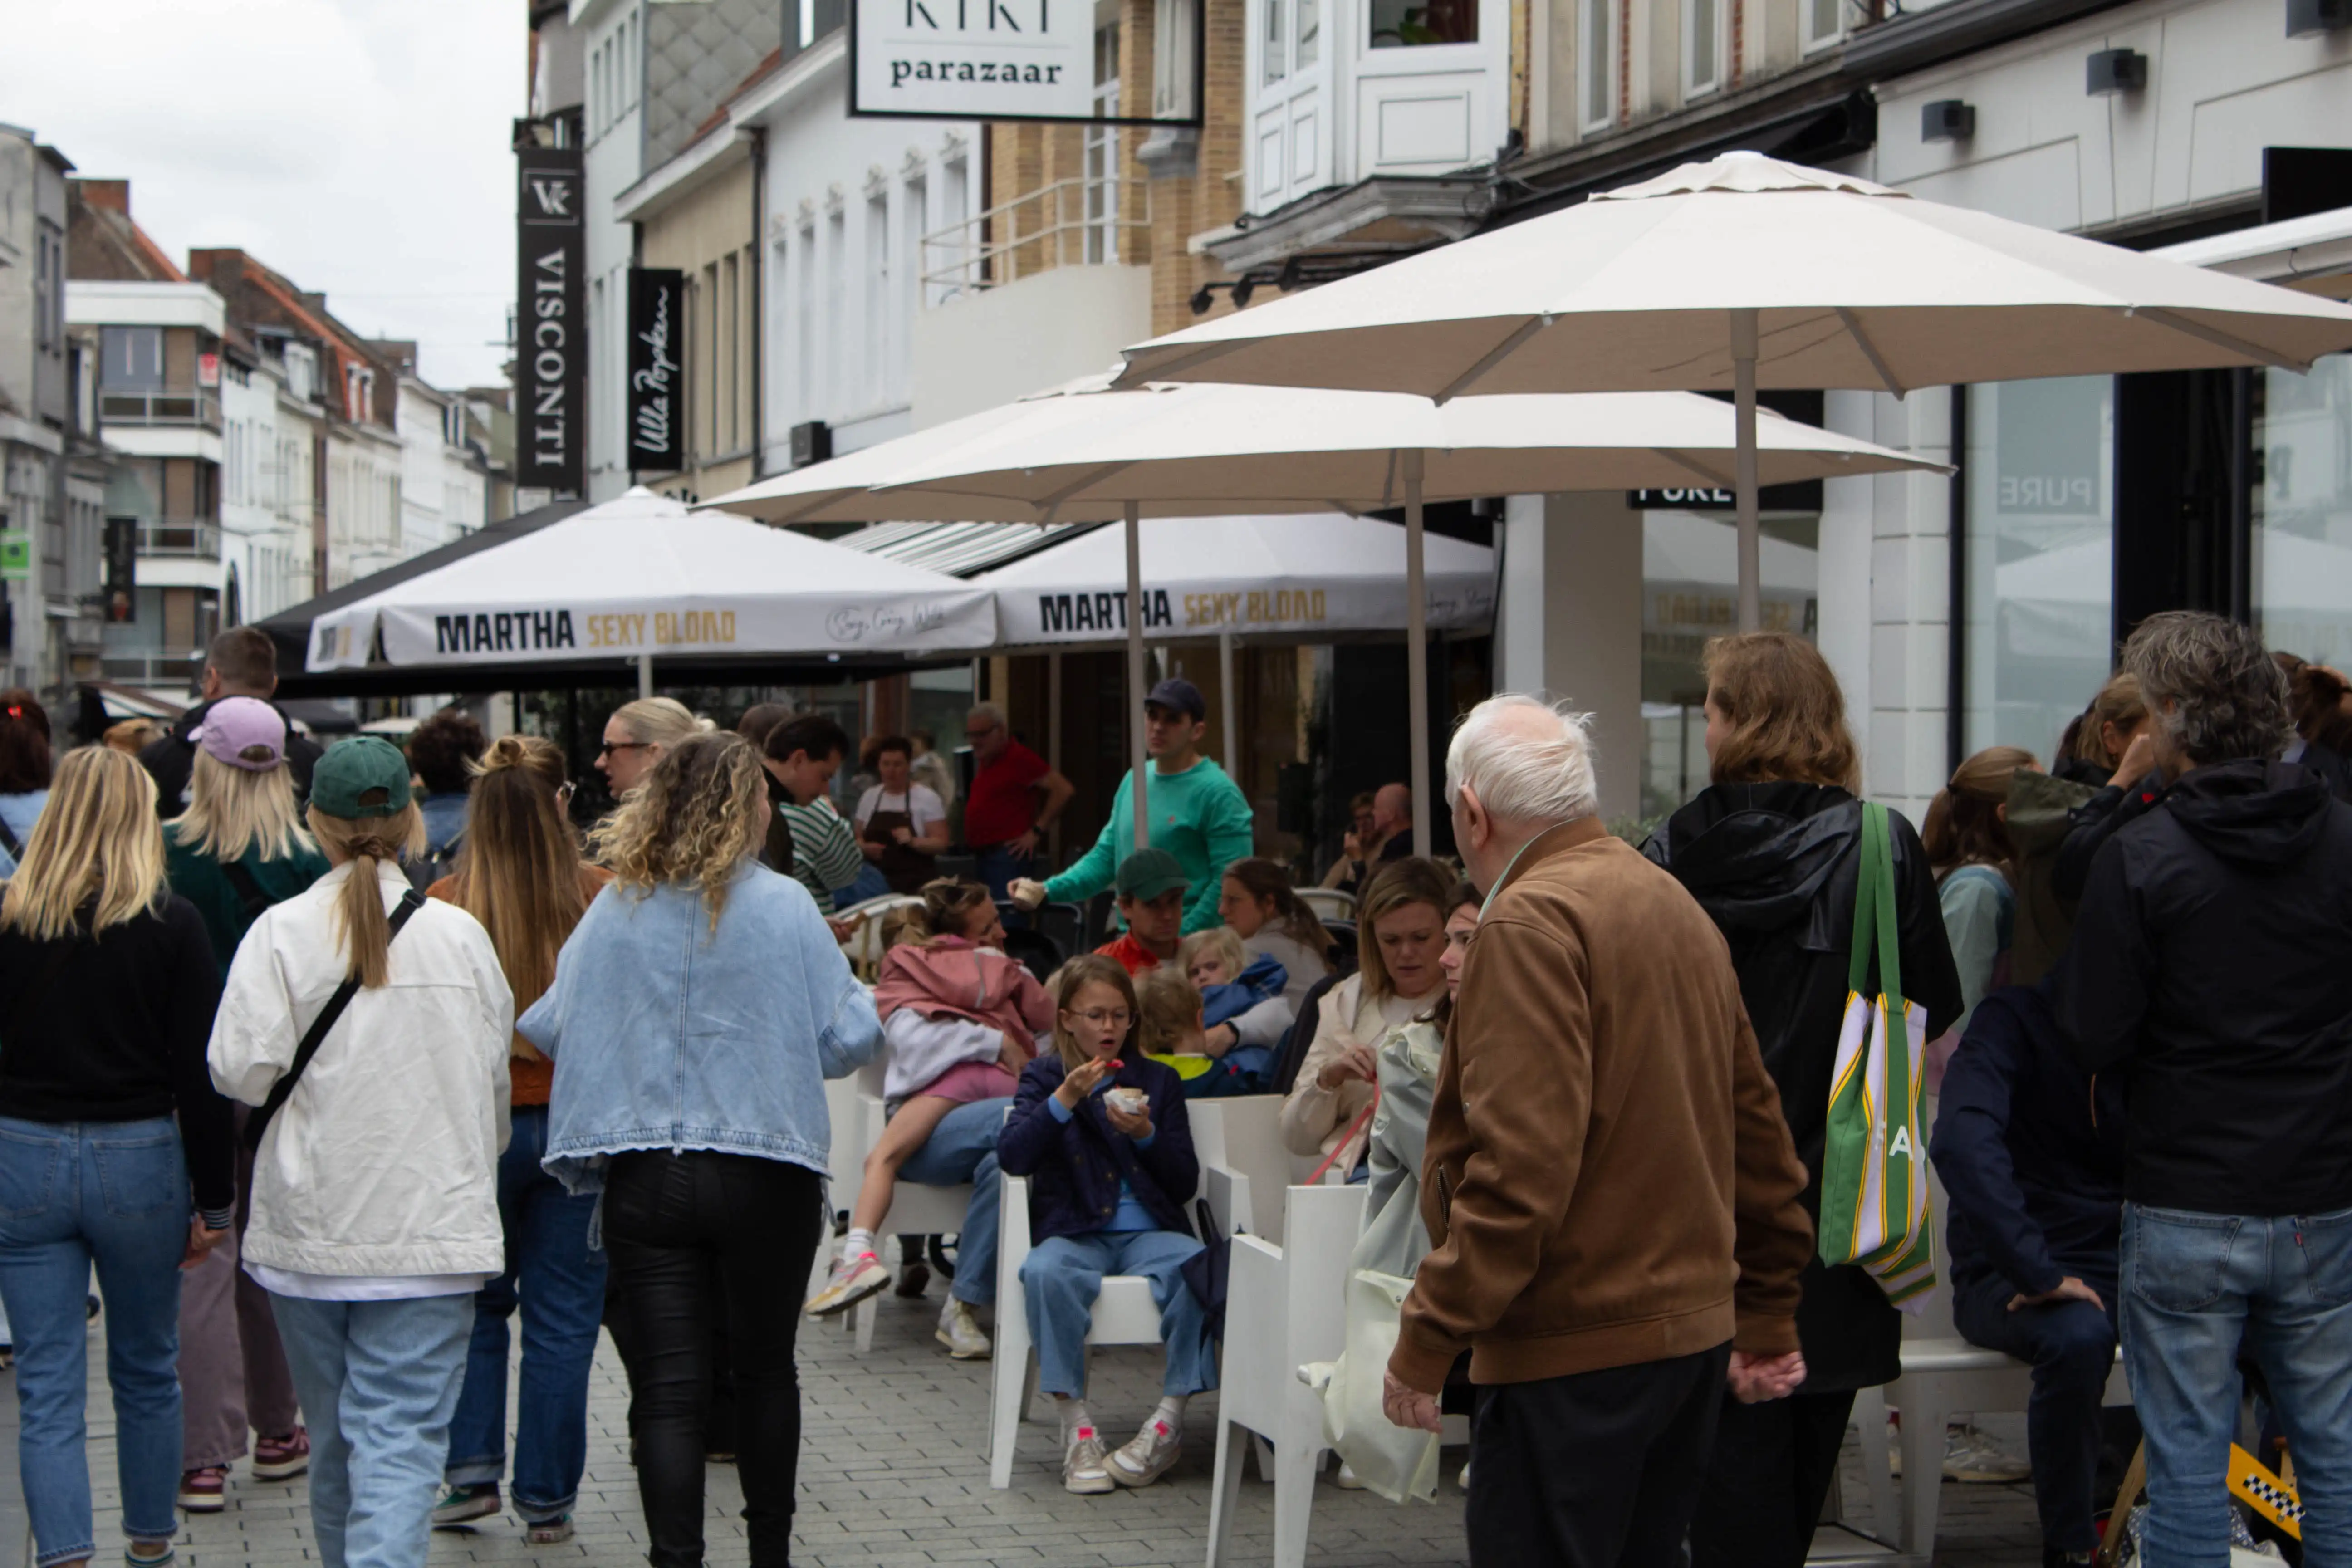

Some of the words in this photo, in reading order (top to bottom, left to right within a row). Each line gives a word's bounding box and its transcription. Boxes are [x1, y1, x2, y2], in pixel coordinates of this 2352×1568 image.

[890, 59, 1063, 88] parazaar
[535, 246, 566, 467] VISCONTI
[434, 609, 576, 654] MARTHA
[587, 613, 647, 647] SEXY
[654, 610, 736, 645] BLOND
[1039, 588, 1173, 633] MARTHA
[1182, 590, 1241, 627] SEXY
